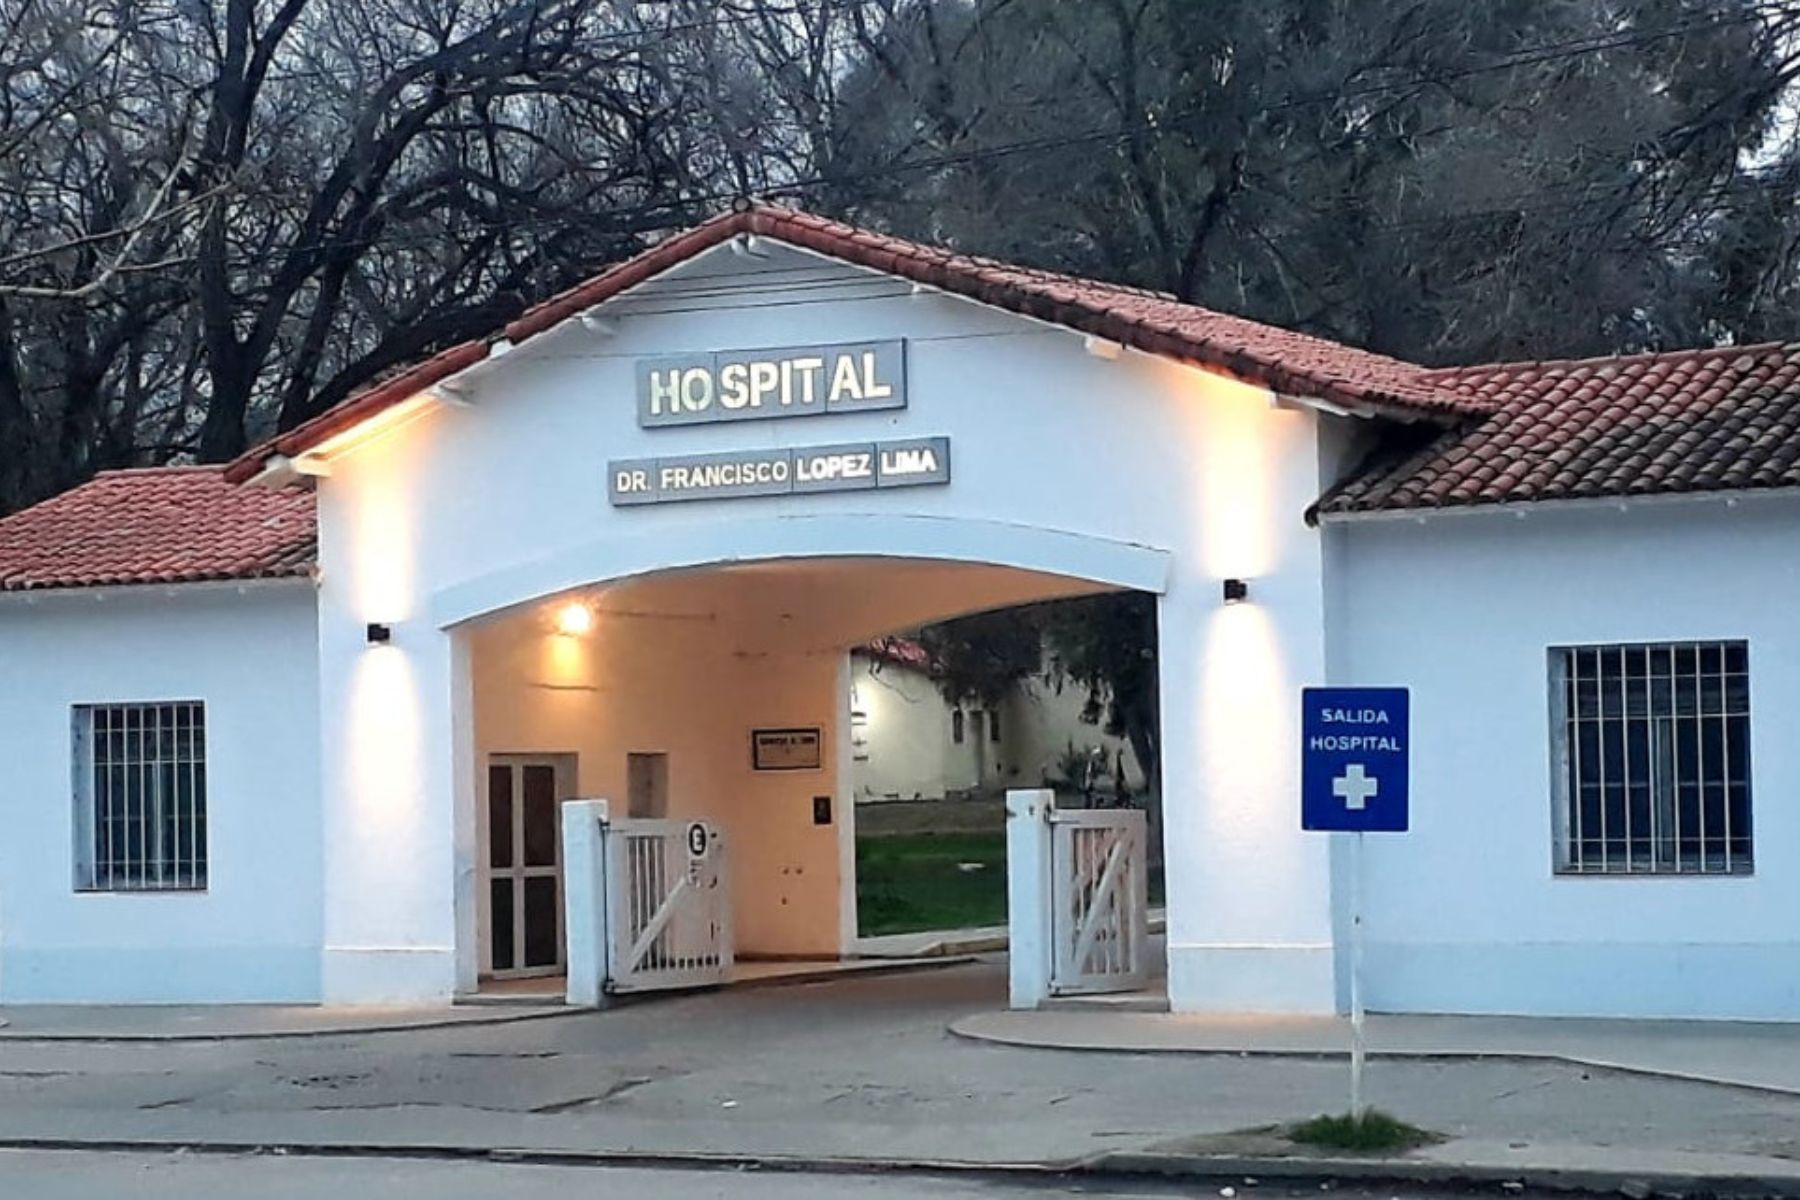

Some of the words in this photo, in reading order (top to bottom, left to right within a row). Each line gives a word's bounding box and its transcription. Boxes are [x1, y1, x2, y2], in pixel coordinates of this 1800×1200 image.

[650, 353, 891, 415] HOSPITAL
[616, 472, 650, 492] DR.
[661, 461, 788, 488] FRANCISCO
[797, 454, 871, 480] LOPEZ
[881, 450, 936, 474] LIMA
[1321, 709, 1389, 724] SALIDA
[1310, 736, 1400, 751] HOSPITAL
